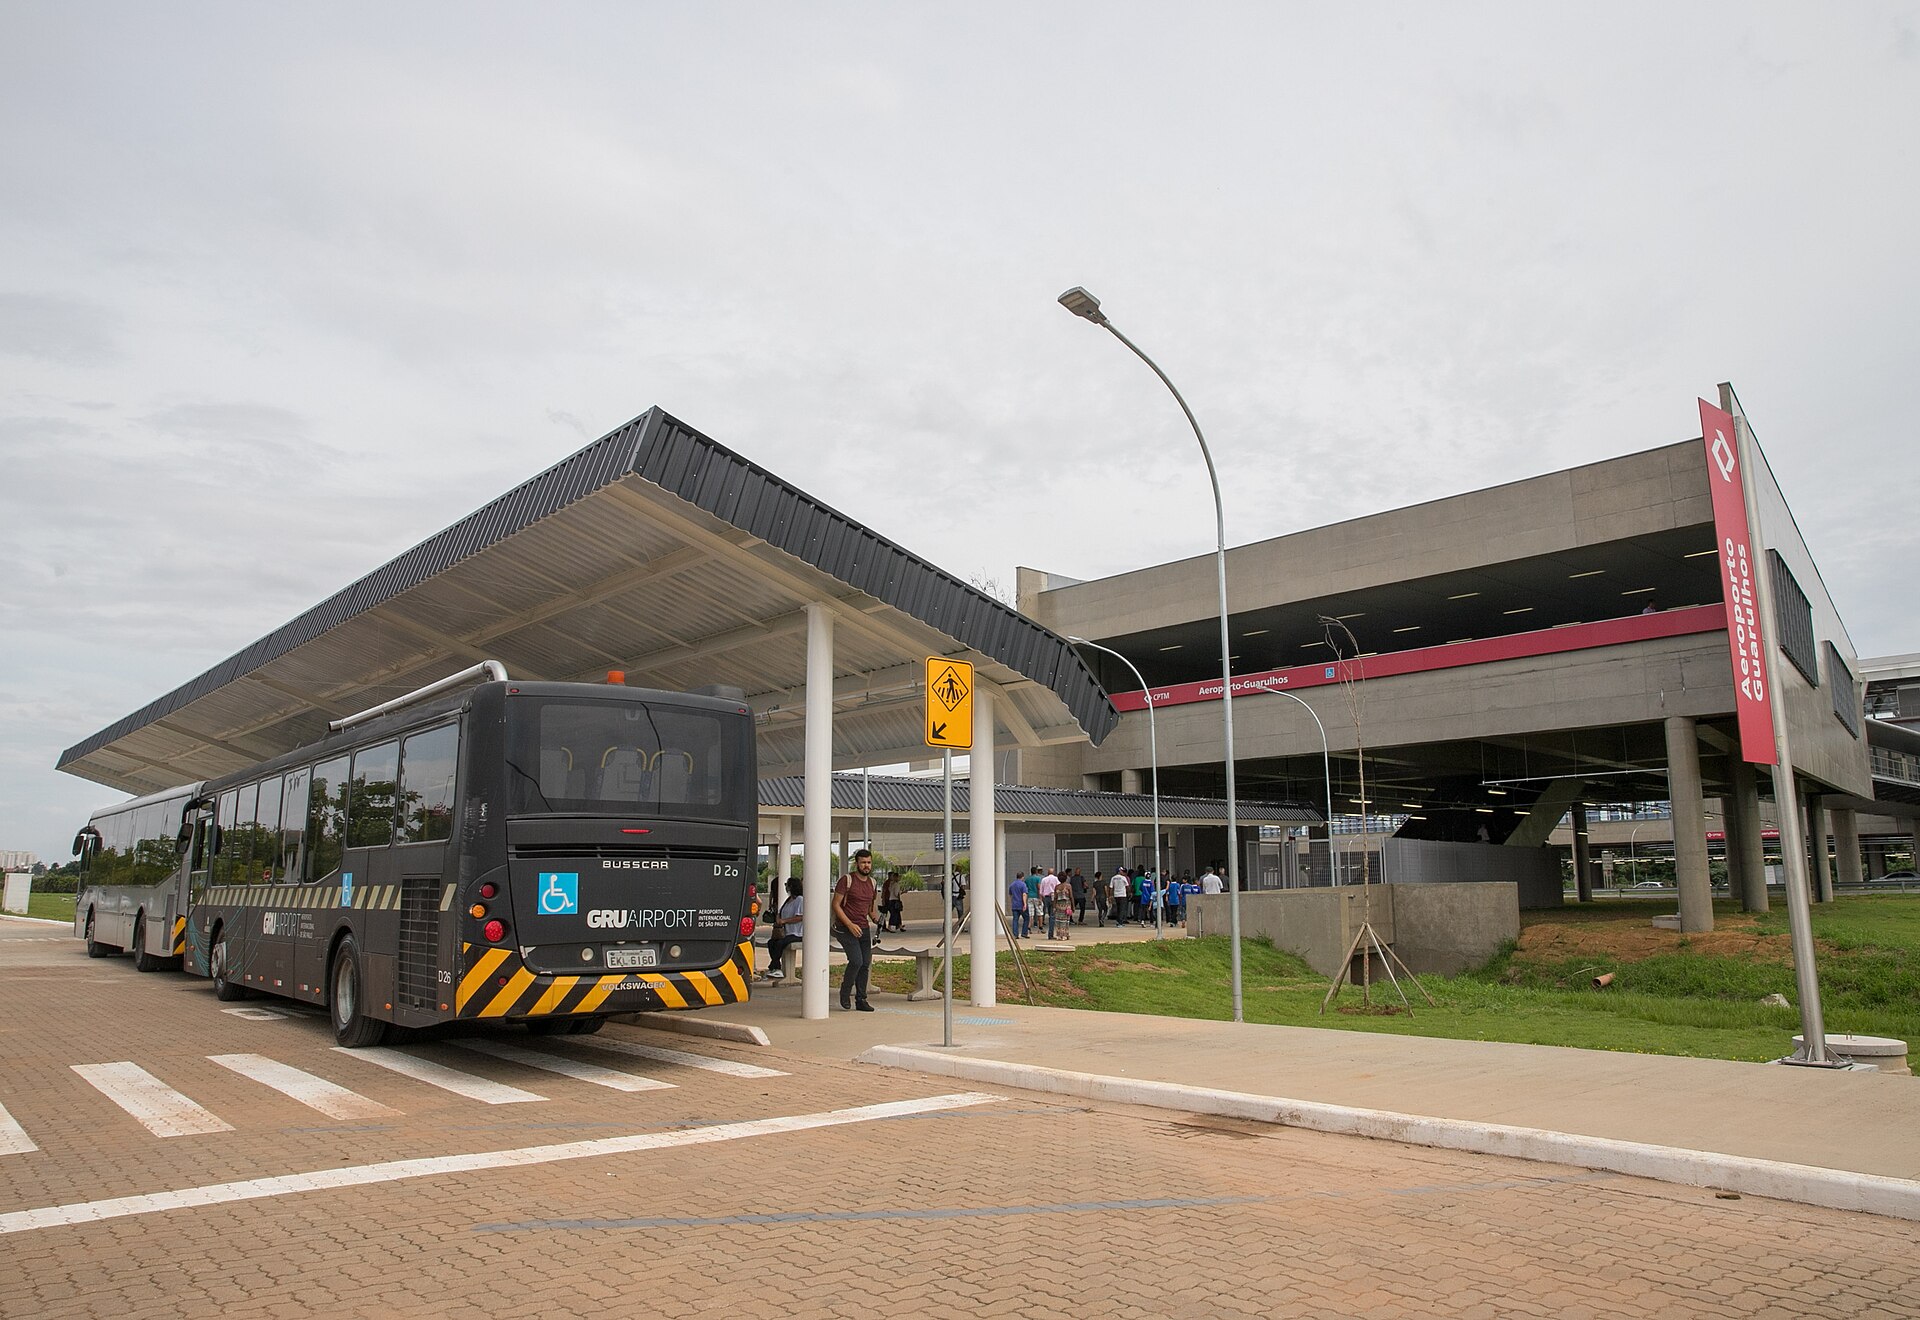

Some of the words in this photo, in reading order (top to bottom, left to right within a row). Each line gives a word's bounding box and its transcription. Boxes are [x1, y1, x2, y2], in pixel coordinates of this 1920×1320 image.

[1725, 537, 1753, 700] Aeroporto
[1737, 543, 1764, 702] Guarulhos
[1198, 675, 1289, 696] Aeroprto-Guarulhos
[1152, 692, 1170, 701] CPTM
[602, 860, 669, 869] BUSSCAR
[713, 864, 721, 876] D
[586, 909, 697, 928] GRUAIRPORT
[610, 956, 628, 966] EKL
[630, 955, 654, 965] 6160
[601, 981, 666, 991] VOLKSWAGEN
